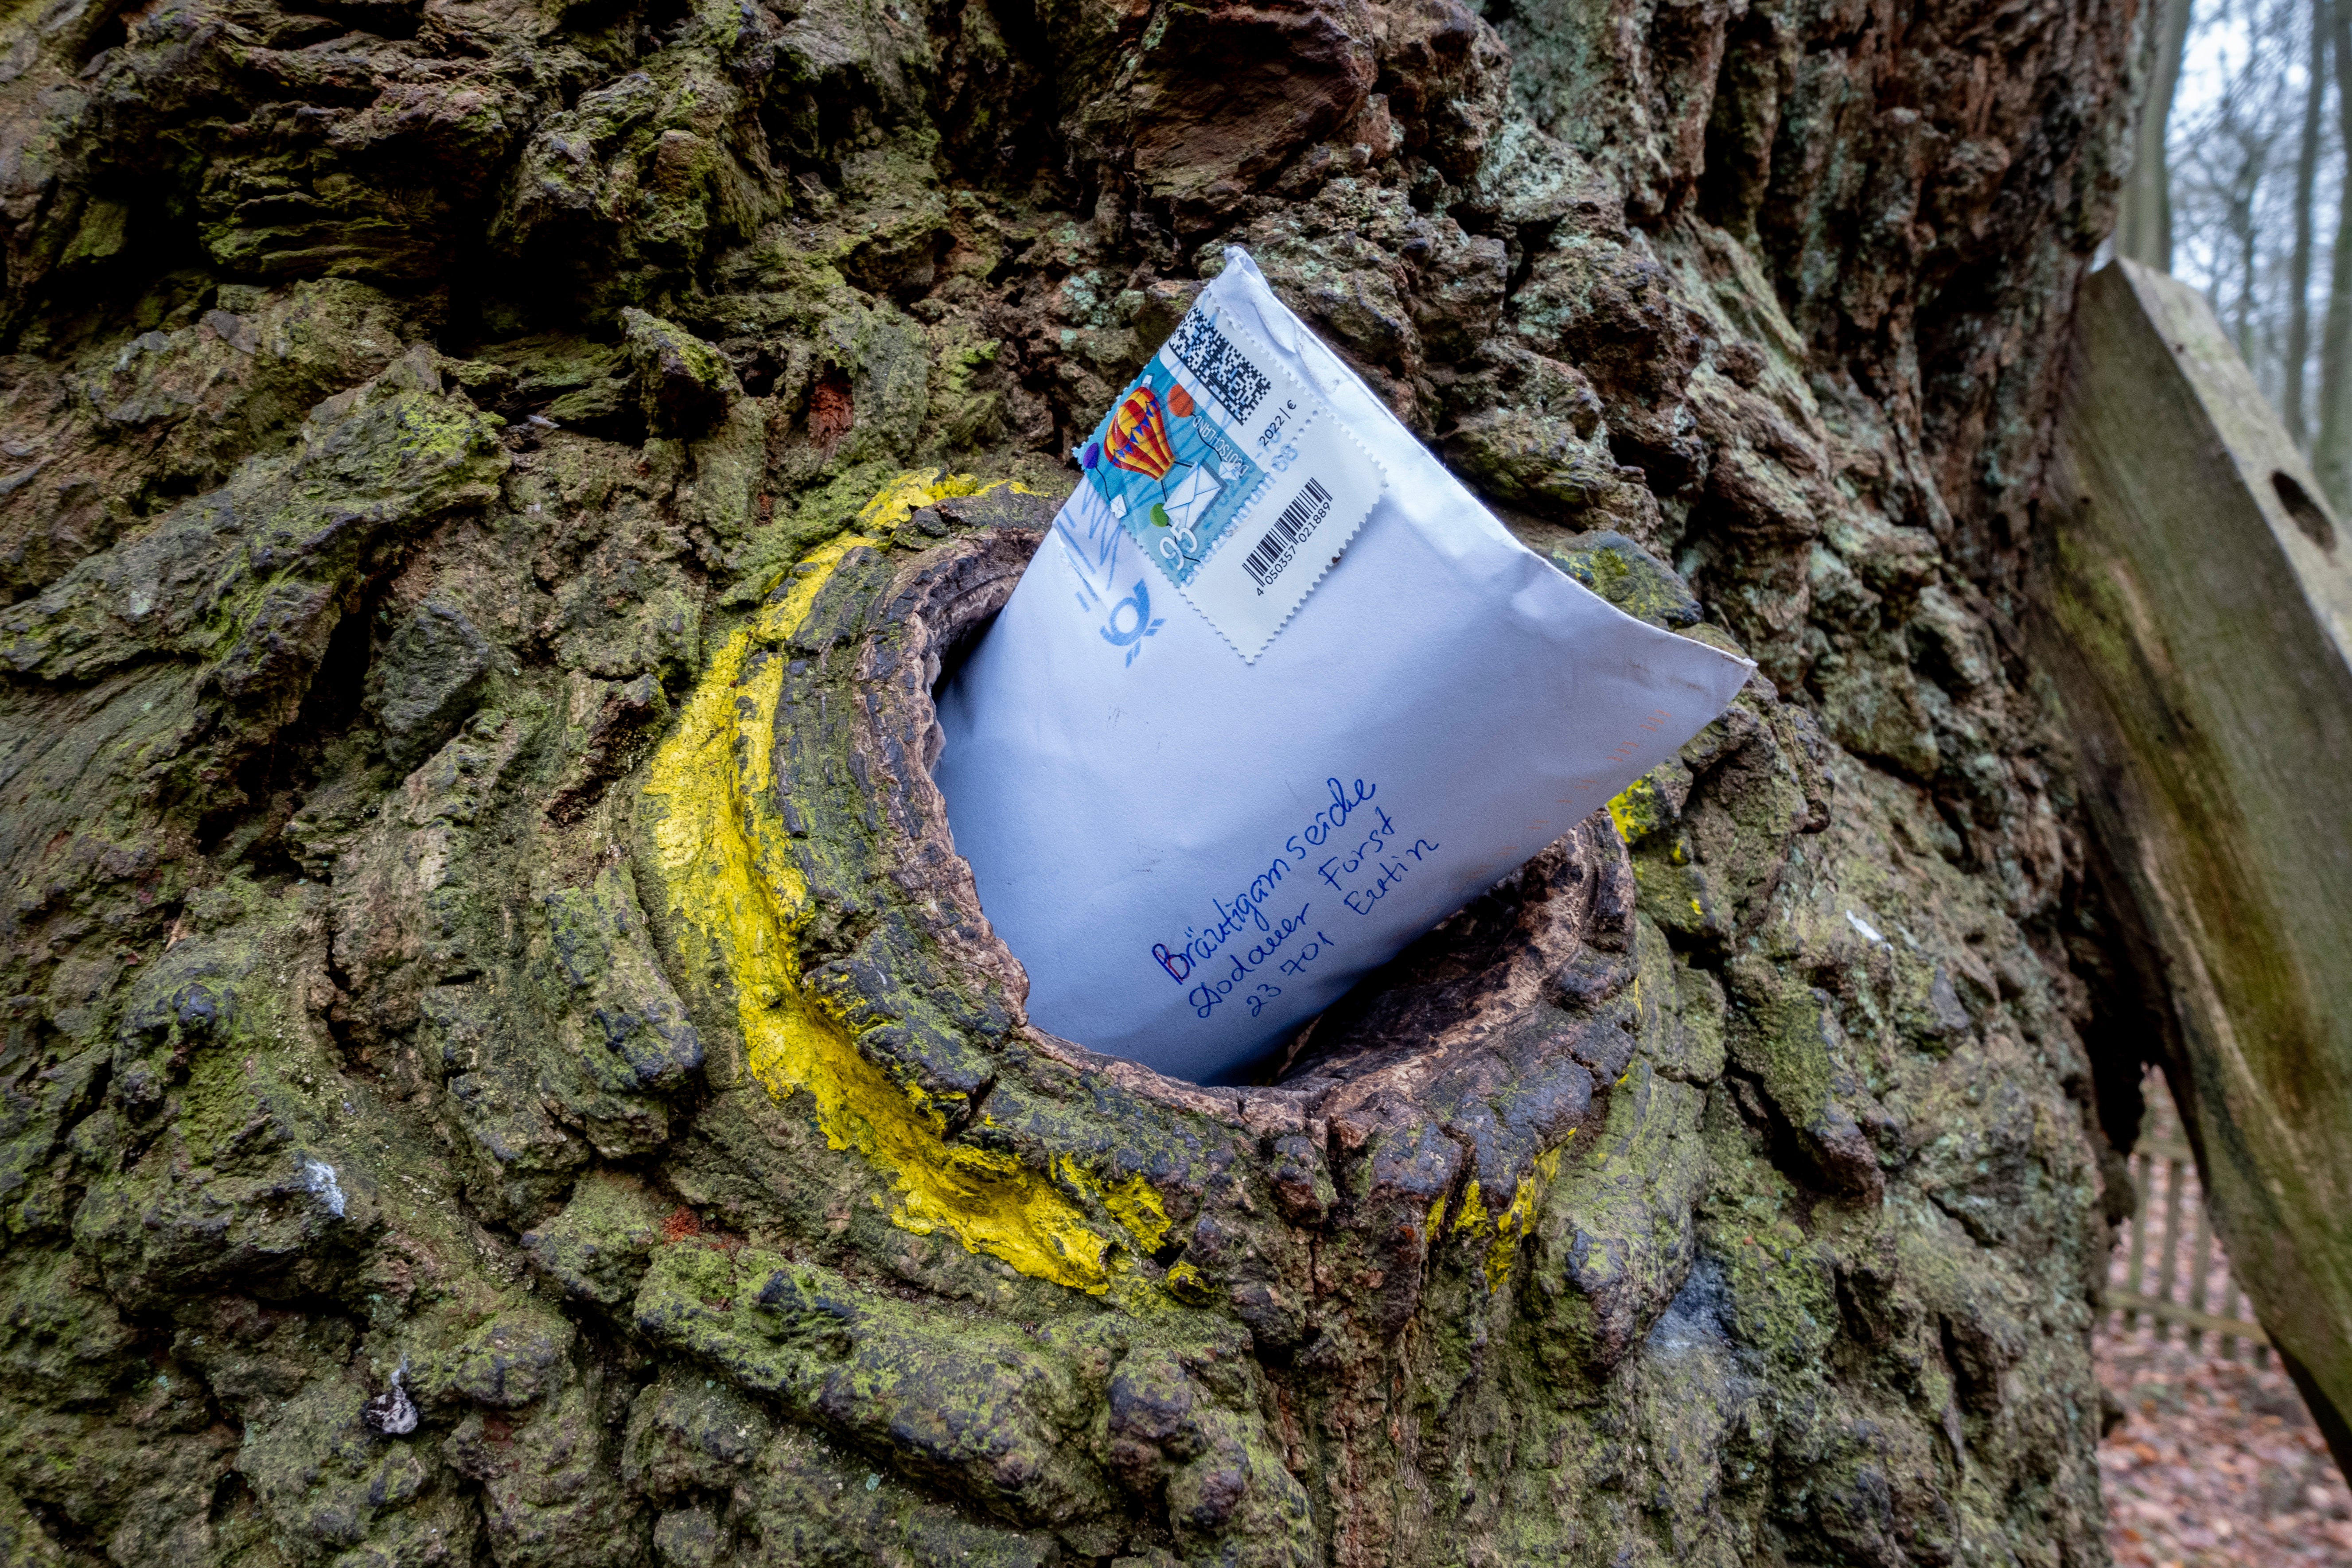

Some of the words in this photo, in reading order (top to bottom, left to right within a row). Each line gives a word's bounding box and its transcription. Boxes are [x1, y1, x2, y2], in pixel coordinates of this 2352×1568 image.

[1259, 416, 1285, 446] 2022
[1287, 400, 1297, 409] €
[1159, 520, 1197, 571] 95
[1343, 839, 1439, 915] Eutin
[1189, 903, 1310, 1018] Dodauer
[1318, 806, 1394, 891] Forst
